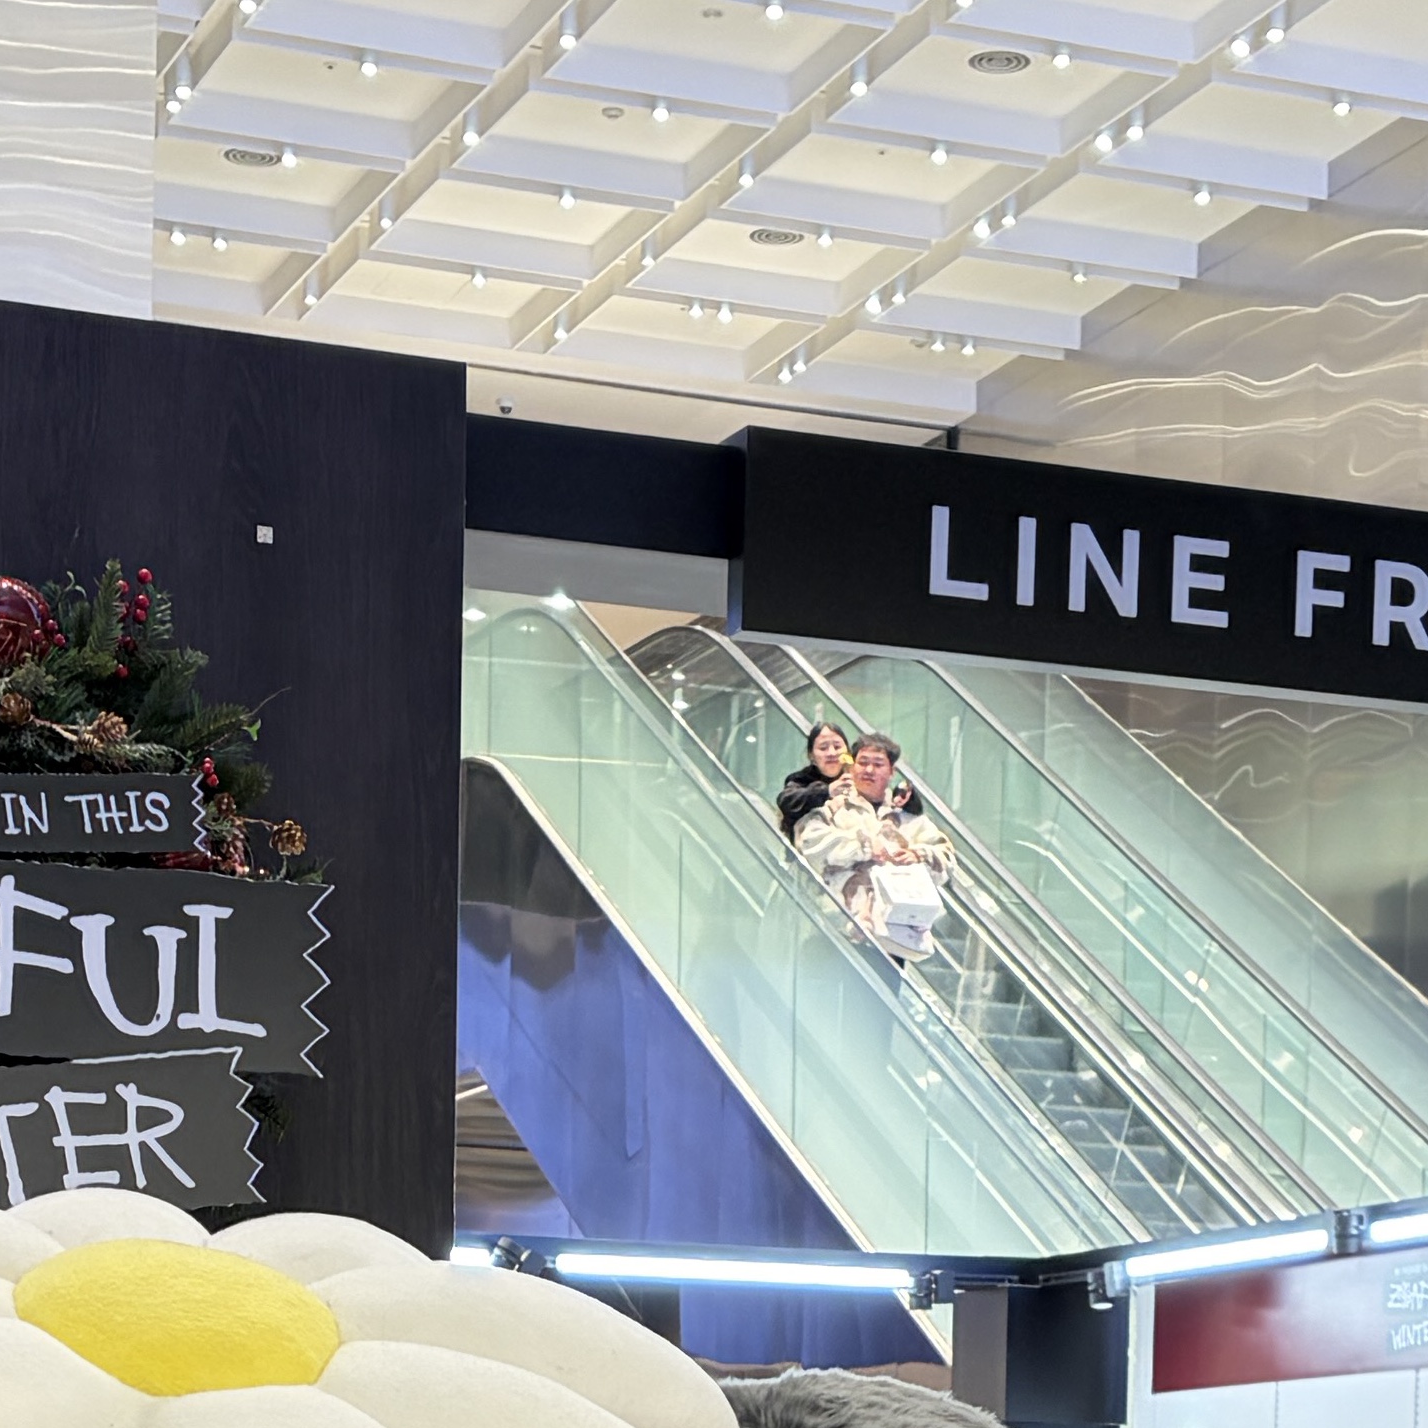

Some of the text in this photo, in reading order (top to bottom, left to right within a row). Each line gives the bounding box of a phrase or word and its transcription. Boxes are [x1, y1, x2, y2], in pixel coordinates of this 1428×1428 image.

[928, 504, 1230, 629] LINE
[3, 791, 51, 837] IN
[64, 790, 171, 835] THIS
